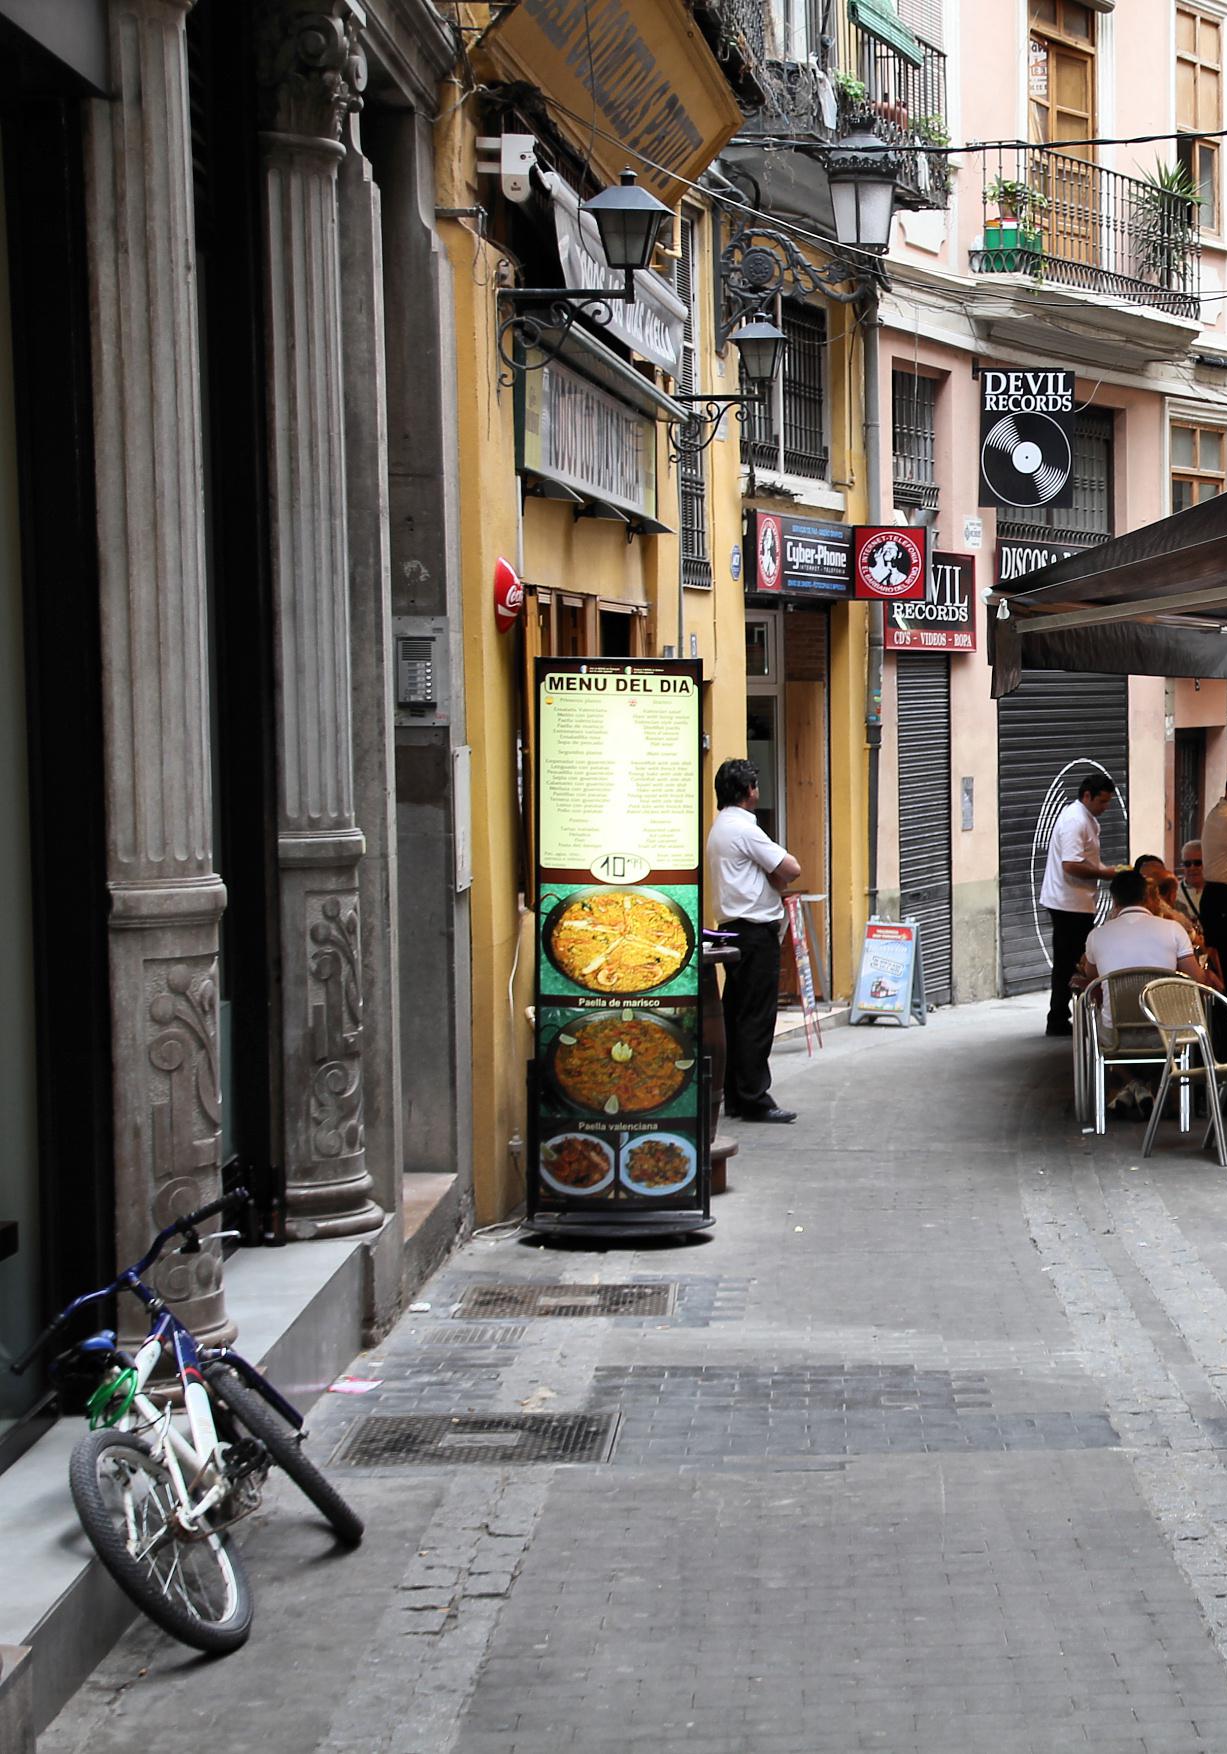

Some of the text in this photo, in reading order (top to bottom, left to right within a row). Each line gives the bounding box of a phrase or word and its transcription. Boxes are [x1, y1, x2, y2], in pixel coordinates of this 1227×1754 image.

[984, 372, 1073, 395] DEVIL
[984, 394, 1073, 413] RECORDS
[892, 602, 969, 622] RECORDS
[920, 632, 947, 647] VIDEOS
[954, 633, 972, 648] ROPA
[549, 676, 690, 693] MENU DEL DIA
[578, 998, 660, 1007] Paella de marisco
[578, 1122, 658, 1131] Paella valenciana
